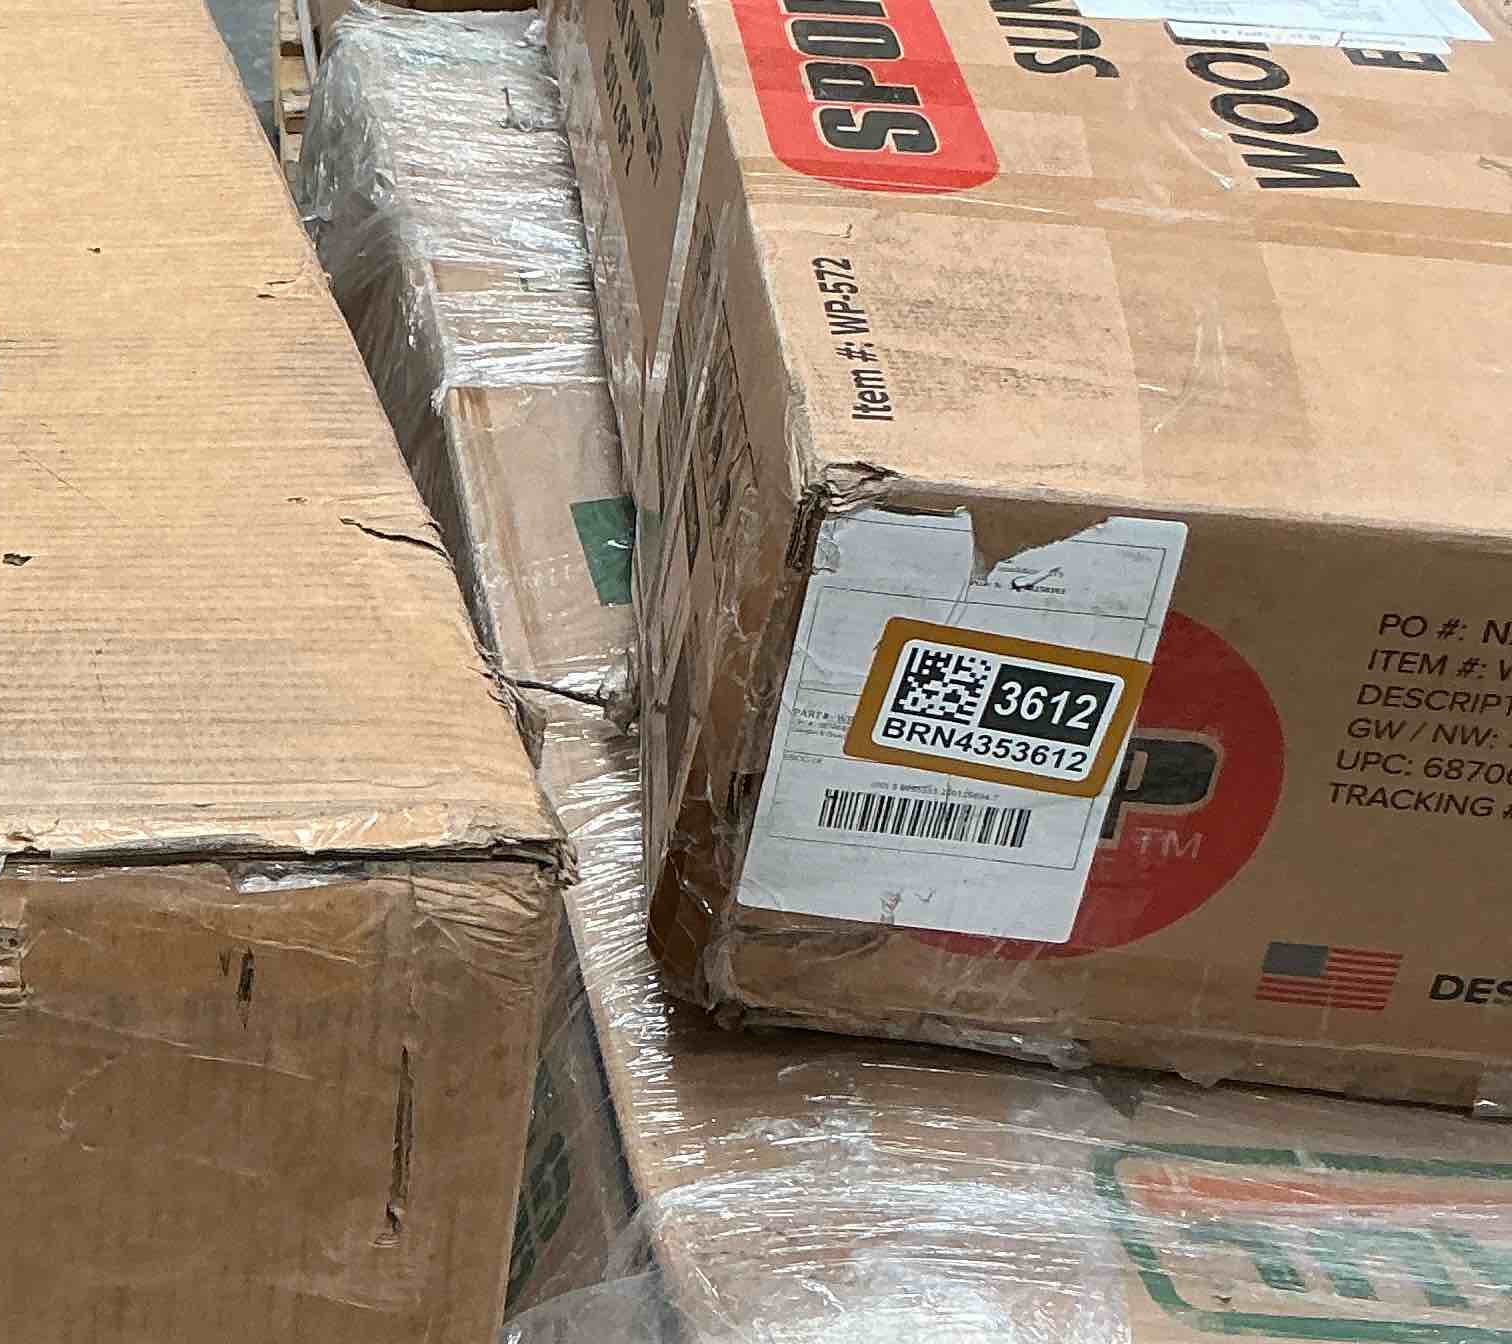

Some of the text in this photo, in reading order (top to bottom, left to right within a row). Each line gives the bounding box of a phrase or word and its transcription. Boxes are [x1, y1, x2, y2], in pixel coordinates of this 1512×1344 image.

[811, 256, 870, 336] WP-572
[850, 368, 895, 421] Item
[1378, 613, 1428, 639] PO
[1435, 618, 1468, 642] #:
[1367, 648, 1449, 676] ITEM
[1456, 657, 1488, 680] #:
[993, 680, 1098, 731] 3612
[881, 716, 1088, 773] BRN4353612
[1346, 717, 1408, 740] GW
[1431, 722, 1499, 749] NW:
[1336, 748, 1414, 776] UPC:
[1328, 782, 1497, 817] TRACKING
[1133, 826, 1203, 859] TM
